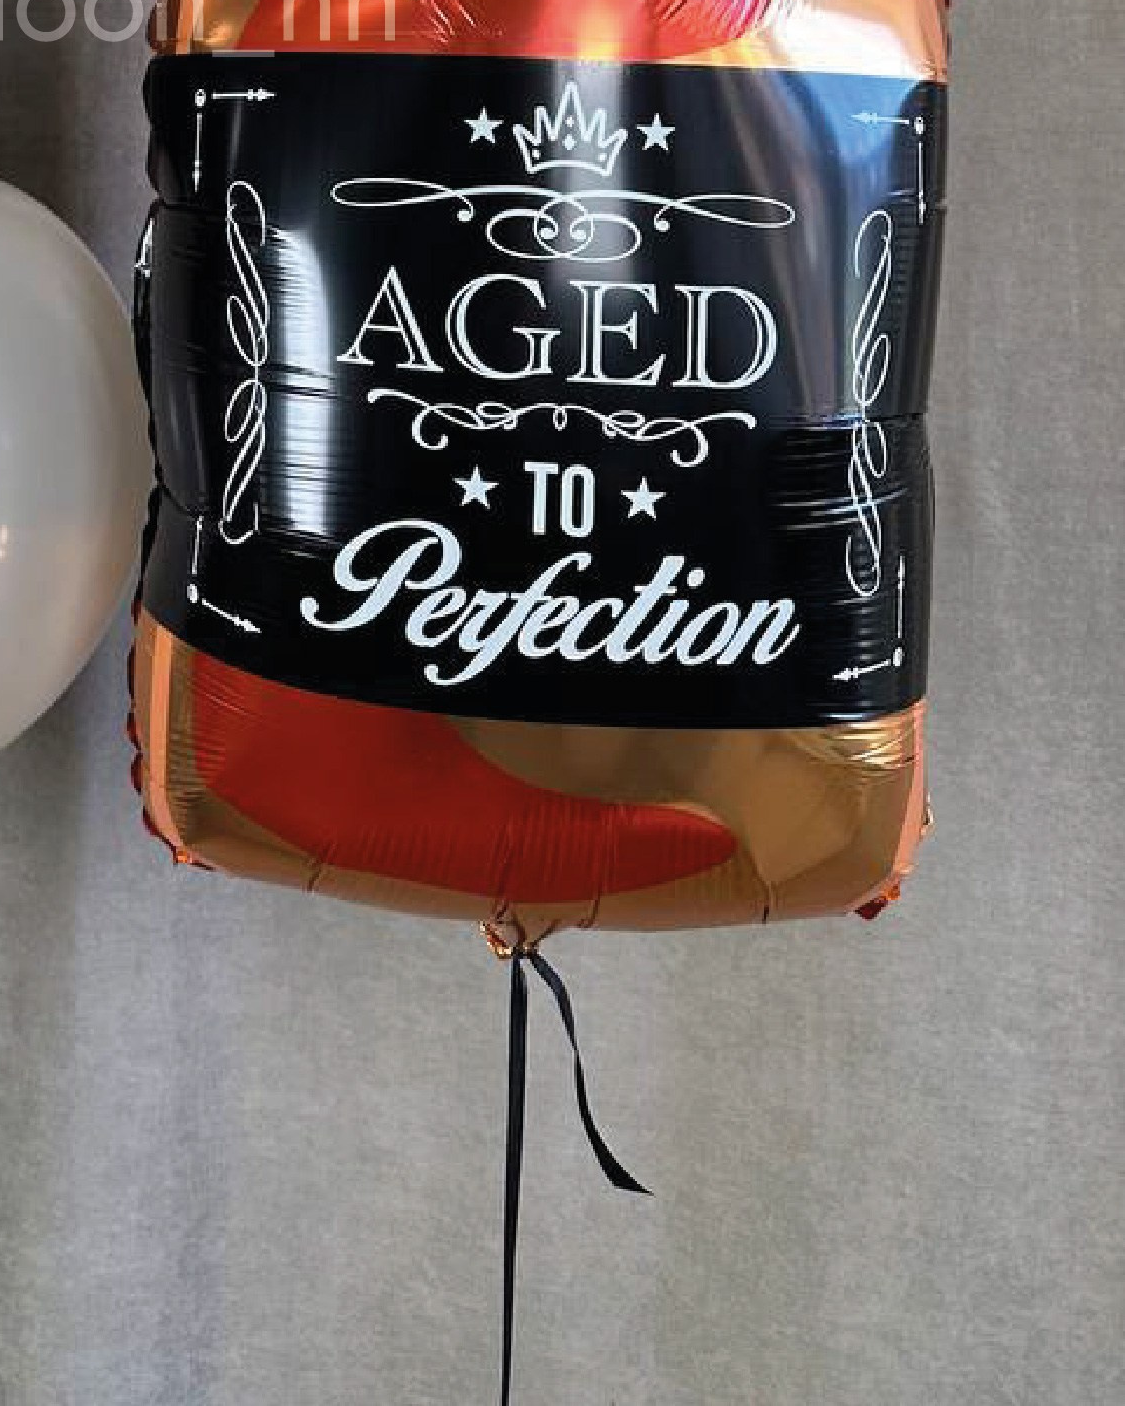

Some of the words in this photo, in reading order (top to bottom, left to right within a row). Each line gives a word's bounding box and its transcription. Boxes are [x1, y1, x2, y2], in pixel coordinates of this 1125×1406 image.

[336, 264, 778, 390] AGED
[523, 460, 596, 538] TO
[299, 517, 802, 687] Perfection
